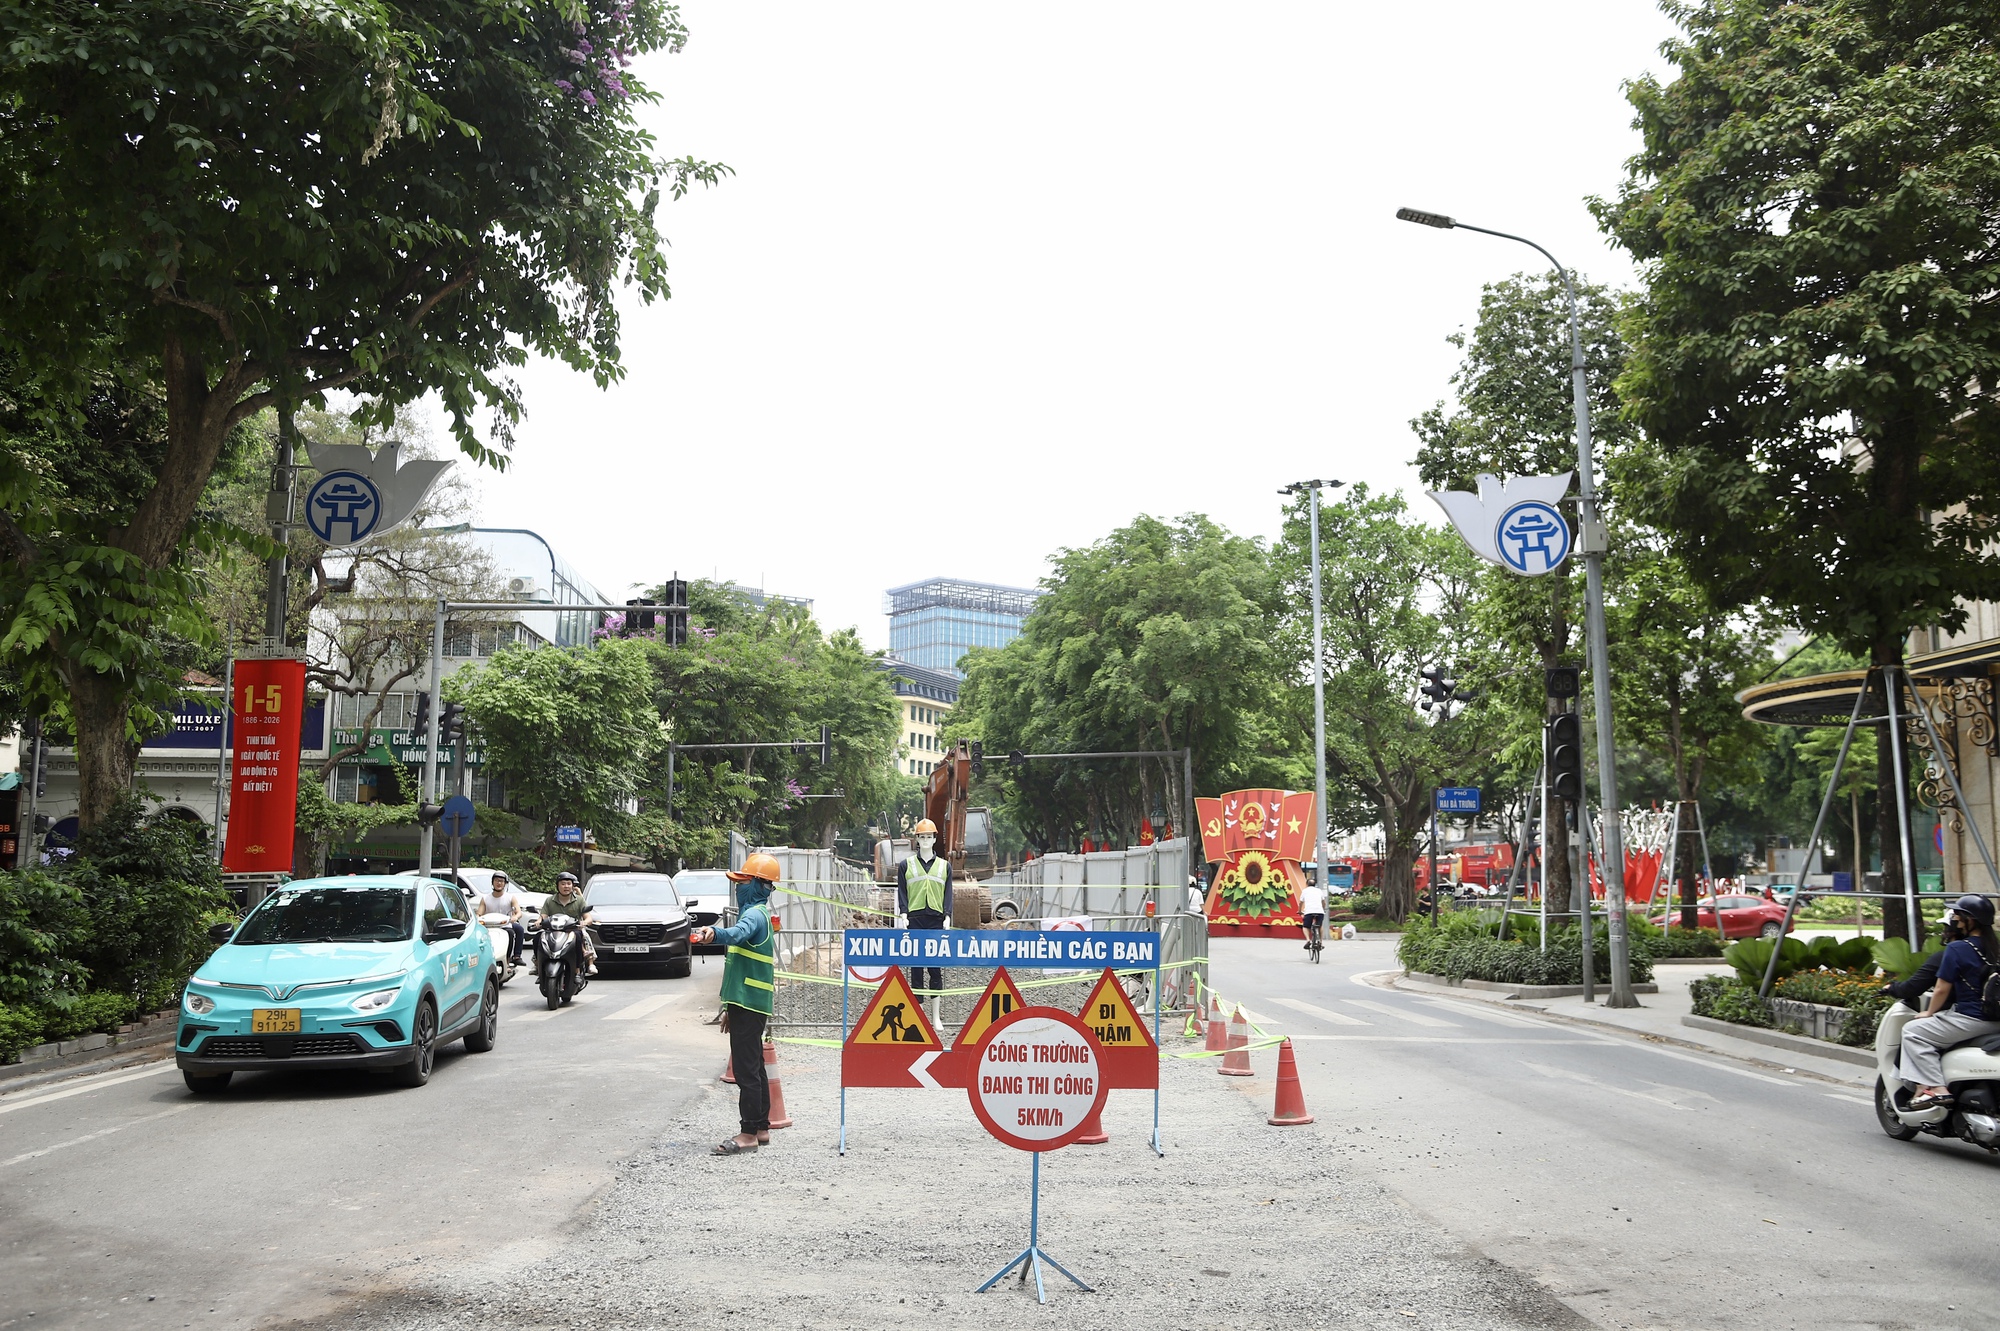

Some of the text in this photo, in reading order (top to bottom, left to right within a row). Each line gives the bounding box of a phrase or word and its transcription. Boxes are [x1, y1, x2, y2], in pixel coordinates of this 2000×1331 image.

[244, 685, 282, 713] 1-5
[263, 716, 281, 724] 2026
[246, 735, 260, 745] TINH
[335, 730, 384, 749] Thu ga
[272, 749, 282, 761] TẾ
[240, 766, 251, 776] LAO
[267, 766, 278, 776] 1/5
[243, 779, 255, 791] BẤT
[1439, 798, 1477, 809] HAI BÀ TRƯNG
[849, 932, 1153, 964] XIN LỖI ĐÃ LÀM PHIỀN CÁC BẠN
[266, 1010, 287, 1021] 29H
[1099, 1004, 1115, 1019] ĐI
[257, 1021, 295, 1032] 911.25
[1091, 1023, 1131, 1045] HẬM
[988, 1040, 1089, 1063] CÔNG TRƯỜNG
[982, 1073, 1093, 1095] ĐANG THI CÔNG
[1017, 1108, 1063, 1126] 5KM/h
